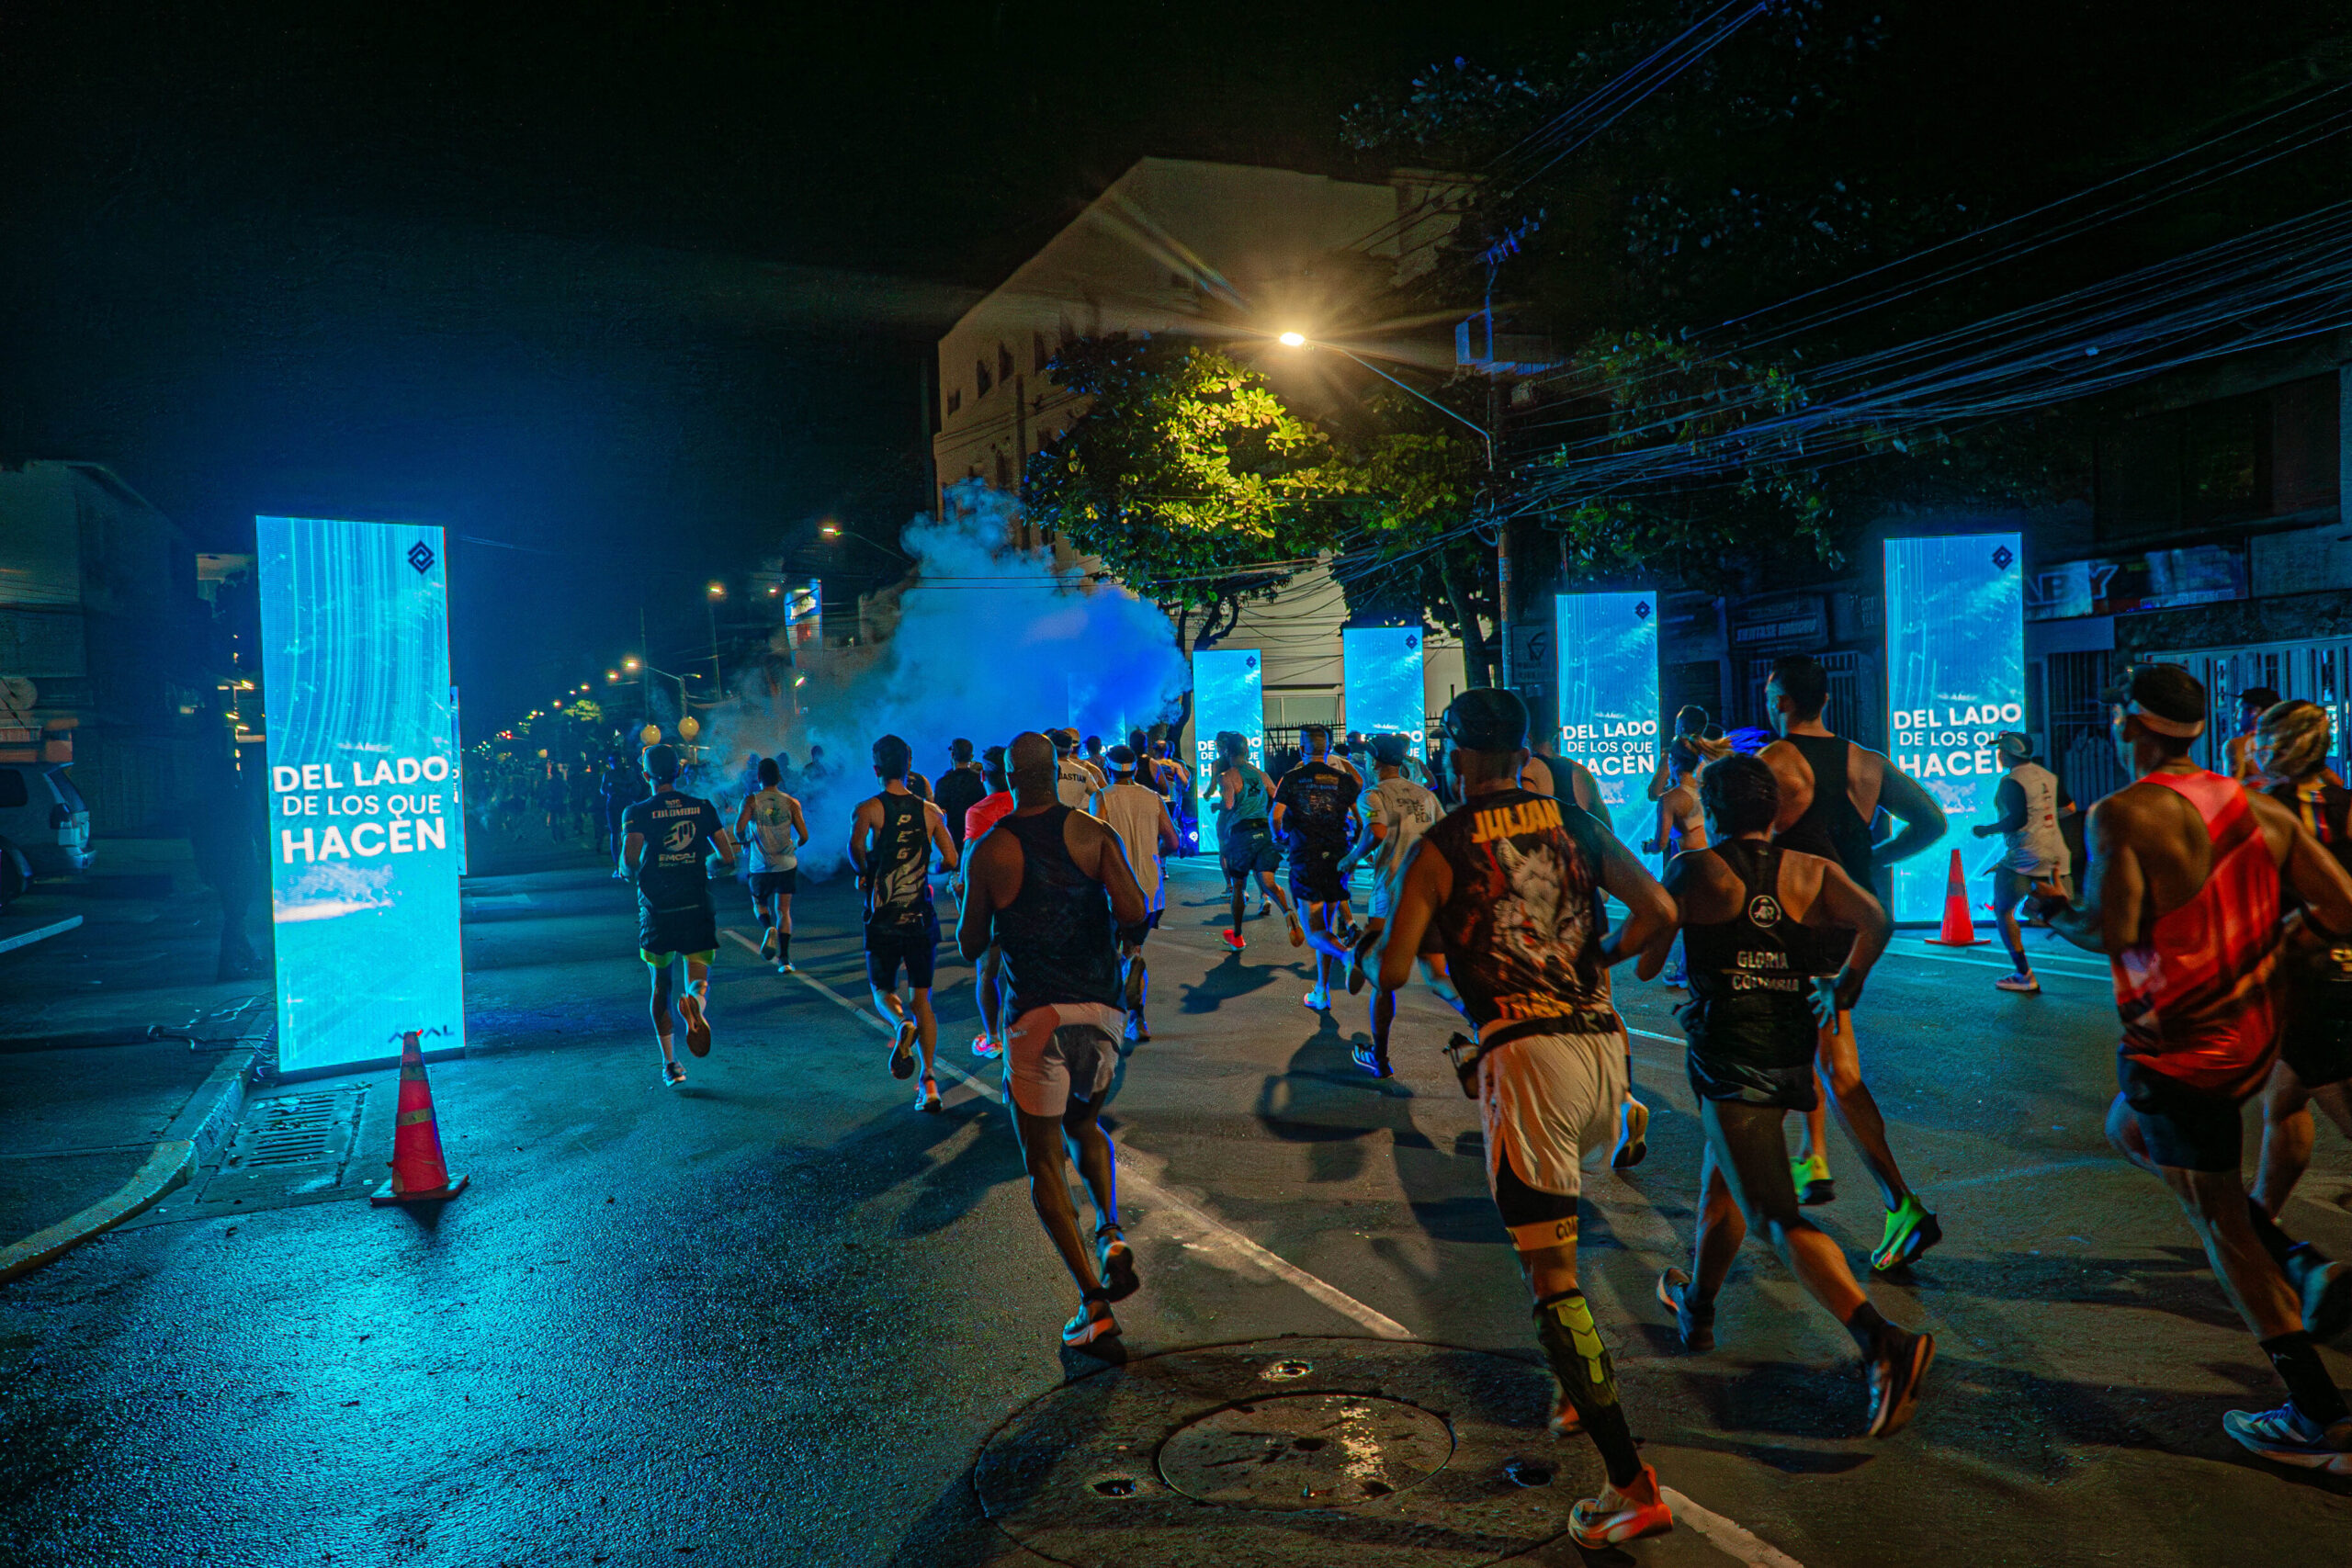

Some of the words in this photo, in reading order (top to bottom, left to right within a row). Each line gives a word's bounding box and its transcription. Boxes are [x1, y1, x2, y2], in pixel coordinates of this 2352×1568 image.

[1894, 708, 1942, 729] DEL
[1949, 703, 2022, 727] LADO
[1563, 724, 1600, 740] DEL
[1603, 719, 1657, 738] LADO
[1899, 731, 1924, 746] DE
[1930, 731, 1968, 746] LOS
[1197, 739, 1216, 751] DE
[1201, 751, 1214, 761] DE
[1567, 741, 1586, 752] DE
[1590, 741, 1618, 752] LOS
[1622, 741, 1654, 756] QUE
[272, 763, 344, 793] DEL
[353, 756, 449, 786] LADO
[1577, 753, 1655, 776] ACEN
[283, 795, 318, 816] DE
[327, 795, 380, 816] LOS
[387, 795, 442, 820] QUE
[1471, 798, 1564, 843] JULIAN
[281, 817, 447, 864] HACEN
[1736, 950, 1789, 969] GLORIA
